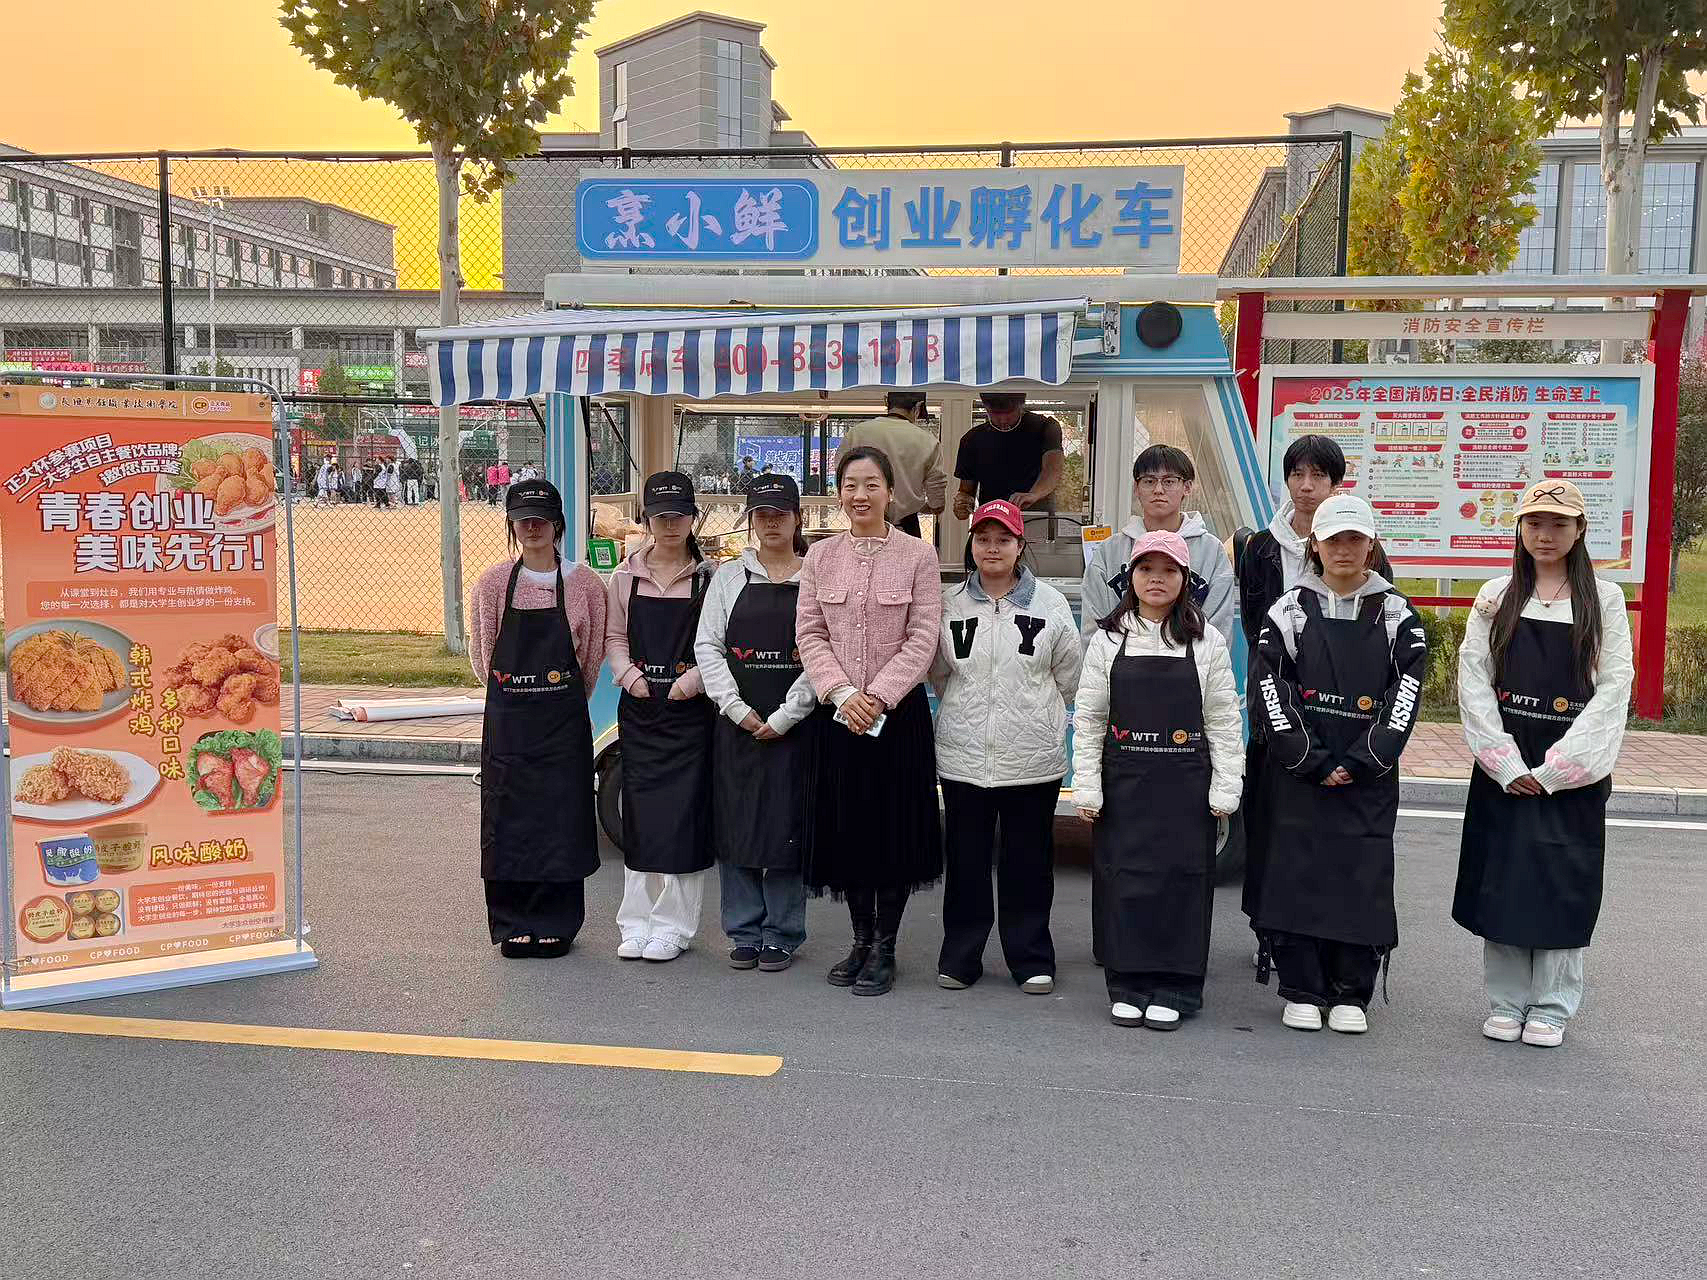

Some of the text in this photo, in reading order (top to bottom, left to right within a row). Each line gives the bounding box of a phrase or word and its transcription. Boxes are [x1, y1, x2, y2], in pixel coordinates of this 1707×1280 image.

[605, 181, 1173, 251] 烹小鲜 创业孵化车
[1403, 317, 1545, 334] 消防安全宣传栏
[1535, 385, 1601, 402] 生命至上
[3, 433, 113, 494] 正大杯参赛项目
[98, 460, 182, 486] 邀您品鉴
[38, 490, 214, 531] 青春创业
[949, 614, 1045, 659] V Y
[756, 651, 780, 660] WTT
[129, 643, 155, 736] 韩式炸鸡
[512, 675, 536, 684] WTT
[1319, 692, 1345, 705] WTT
[1512, 693, 1540, 707] WTT
[158, 688, 185, 780] 多种口味
[1131, 732, 1160, 742] WTT
[151, 838, 249, 866] 风味酸奶
